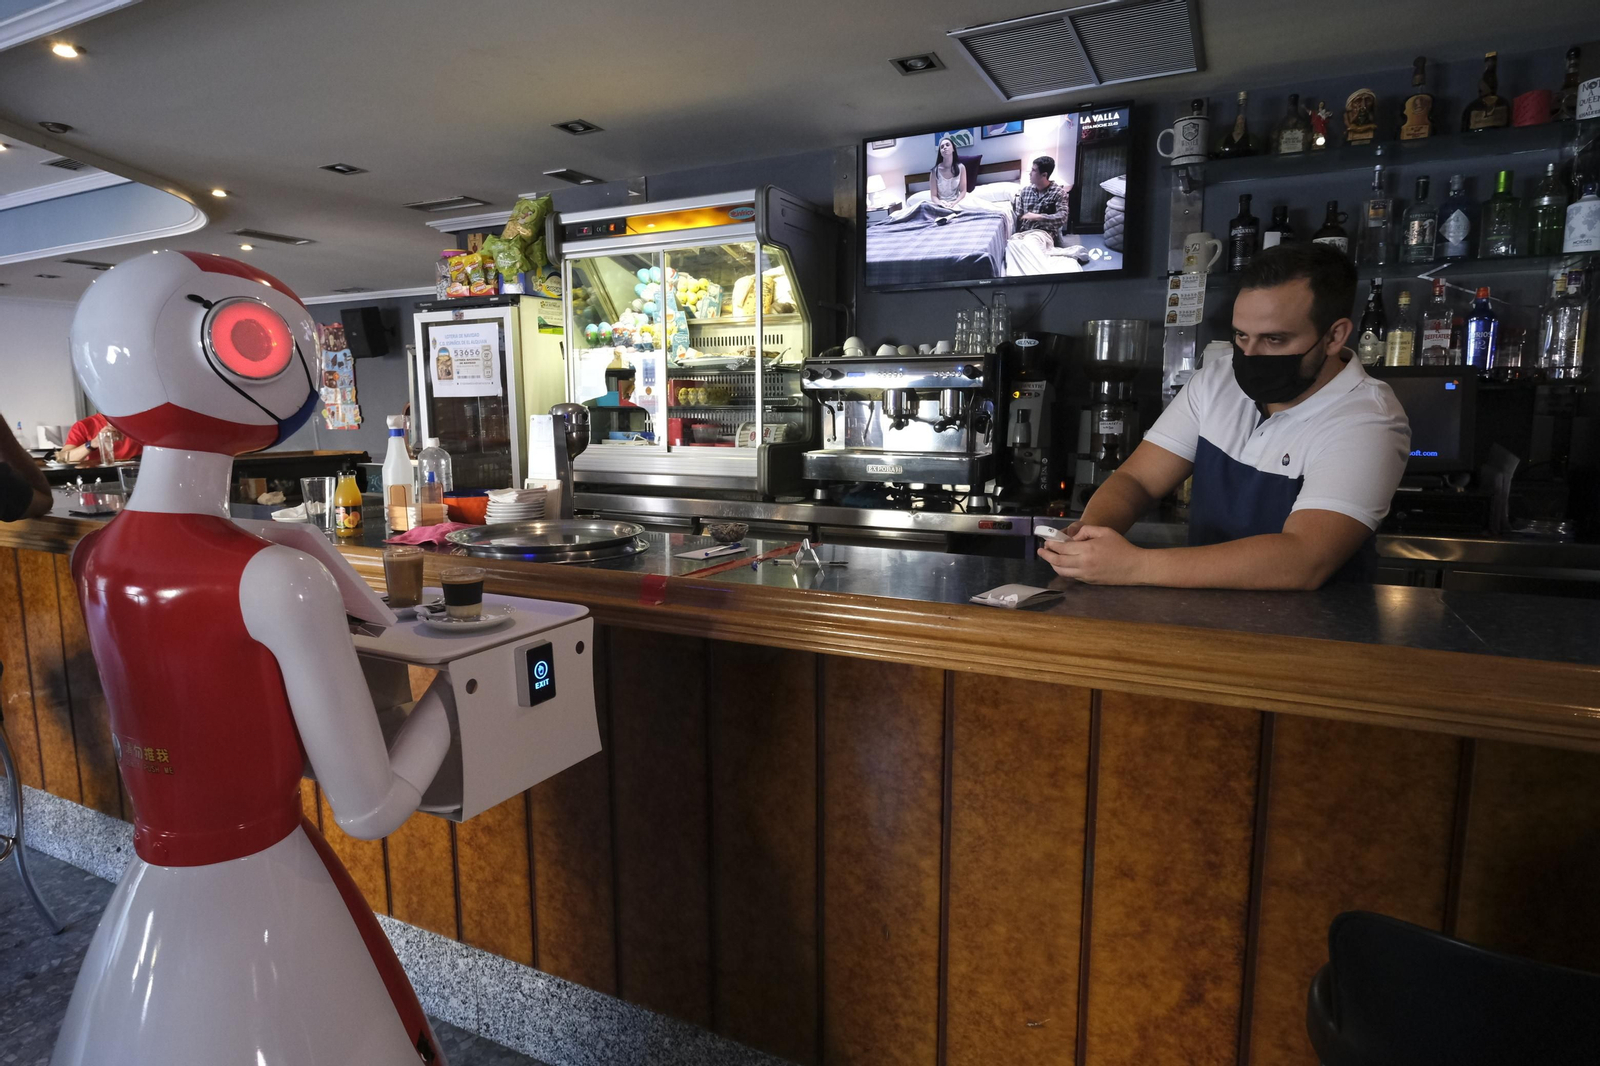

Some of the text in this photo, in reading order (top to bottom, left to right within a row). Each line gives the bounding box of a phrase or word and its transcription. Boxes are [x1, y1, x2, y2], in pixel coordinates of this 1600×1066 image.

[1588, 89, 1594, 97] A
[1079, 111, 1120, 124] LA VALLA
[1424, 333, 1450, 341] BEEFEATER
[453, 349, 480, 357] 53656
[535, 678, 549, 690] EXIT
[143, 764, 160, 773] PUSH
[163, 766, 175, 774] ME
